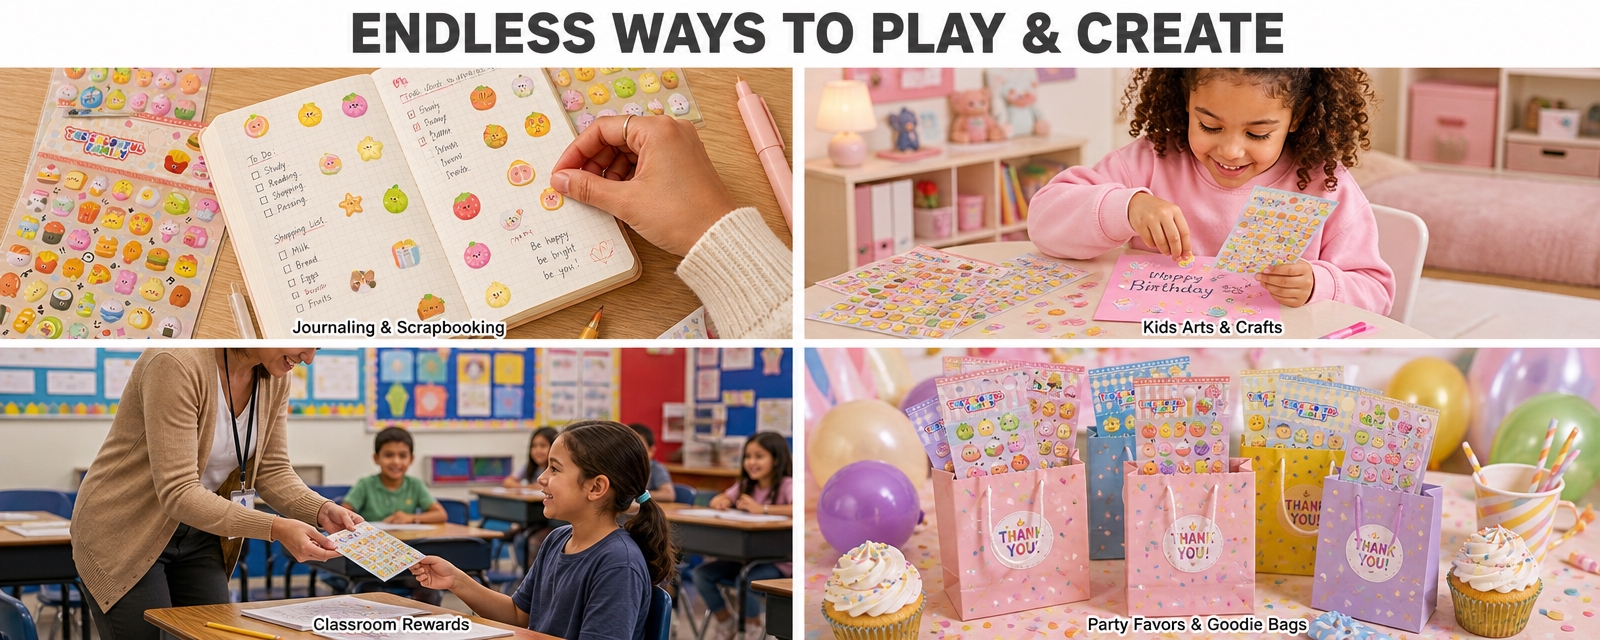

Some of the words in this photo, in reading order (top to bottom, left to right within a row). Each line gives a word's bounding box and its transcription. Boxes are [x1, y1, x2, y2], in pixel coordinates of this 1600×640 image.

[291, 242, 310, 256] Milk
[530, 241, 542, 251] Be
[536, 256, 549, 265] be
[543, 270, 555, 280] be
[1129, 279, 1214, 299] Birthday
[1290, 513, 1320, 526] YOU!
[1177, 546, 1209, 560] YOU!
[1358, 552, 1389, 571] YOU!
